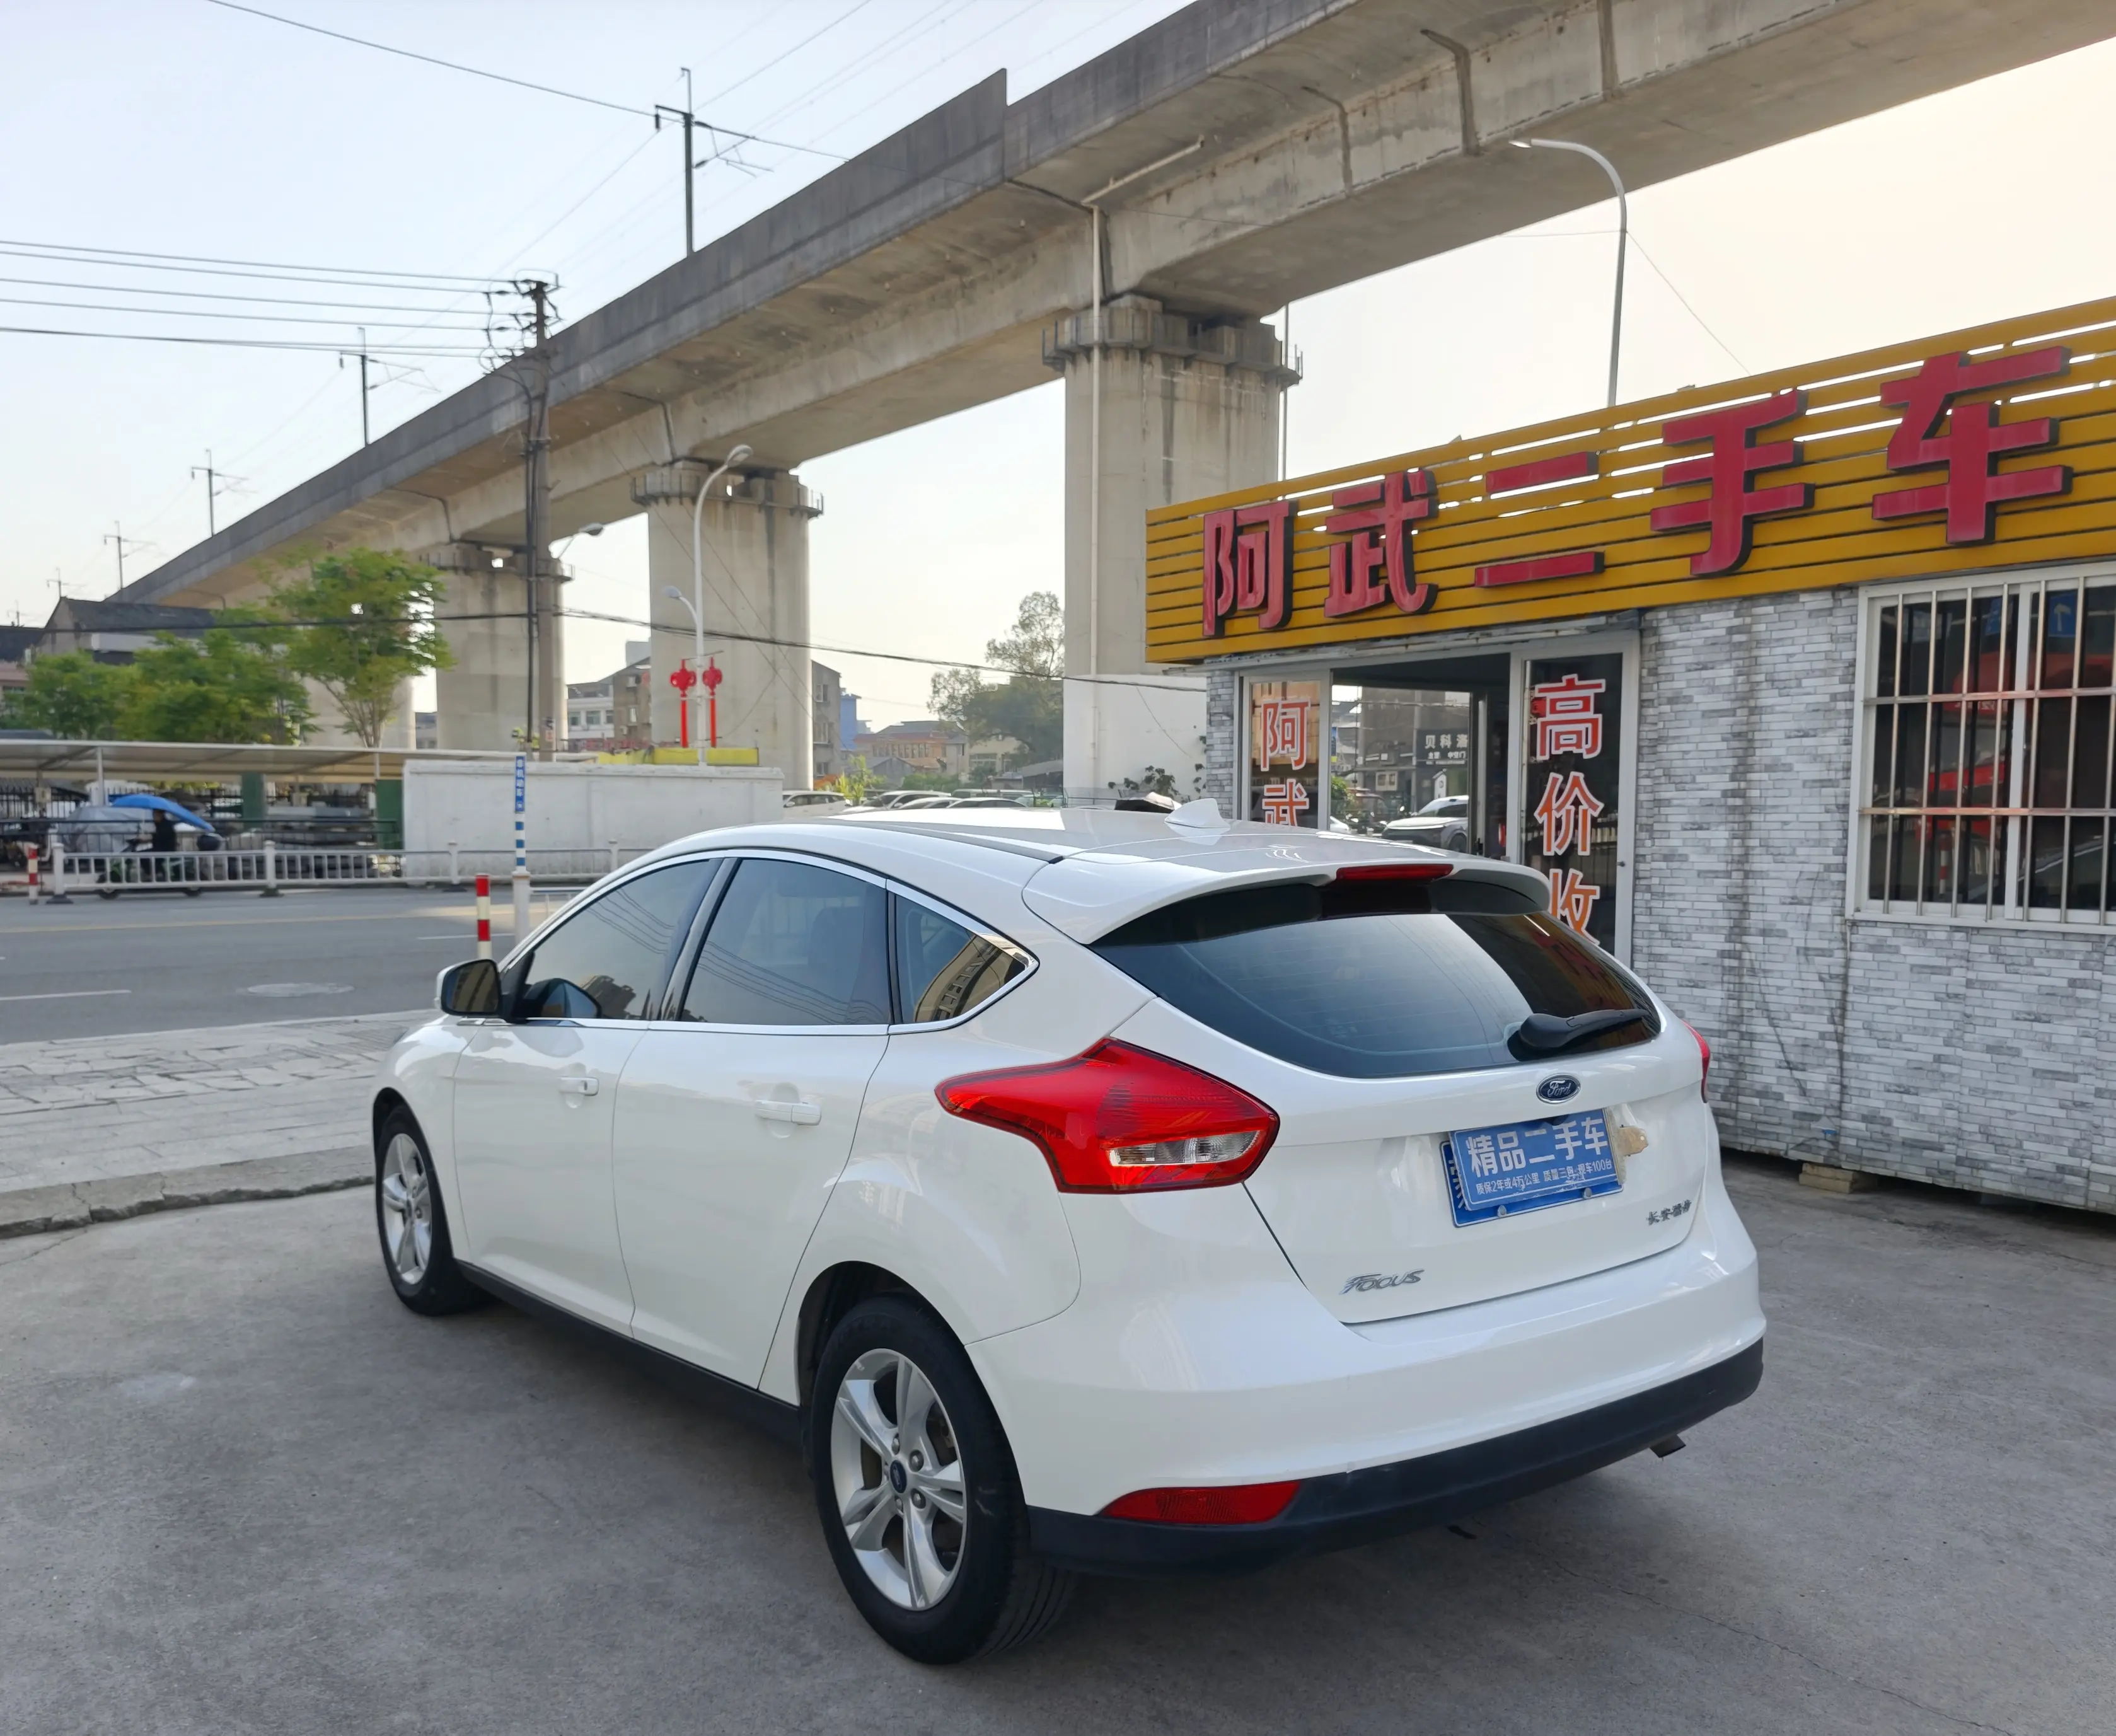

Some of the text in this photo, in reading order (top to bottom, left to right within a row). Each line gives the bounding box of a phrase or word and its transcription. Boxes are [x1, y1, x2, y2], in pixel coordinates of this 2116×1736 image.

[1202, 345, 2073, 637] 阿武二手车
[1261, 697, 1309, 826] 阿武
[1534, 673, 1606, 946] 高价收
[1466, 1116, 1608, 1178] 精品二手车
[1547, 1080, 1571, 1097] Ford
